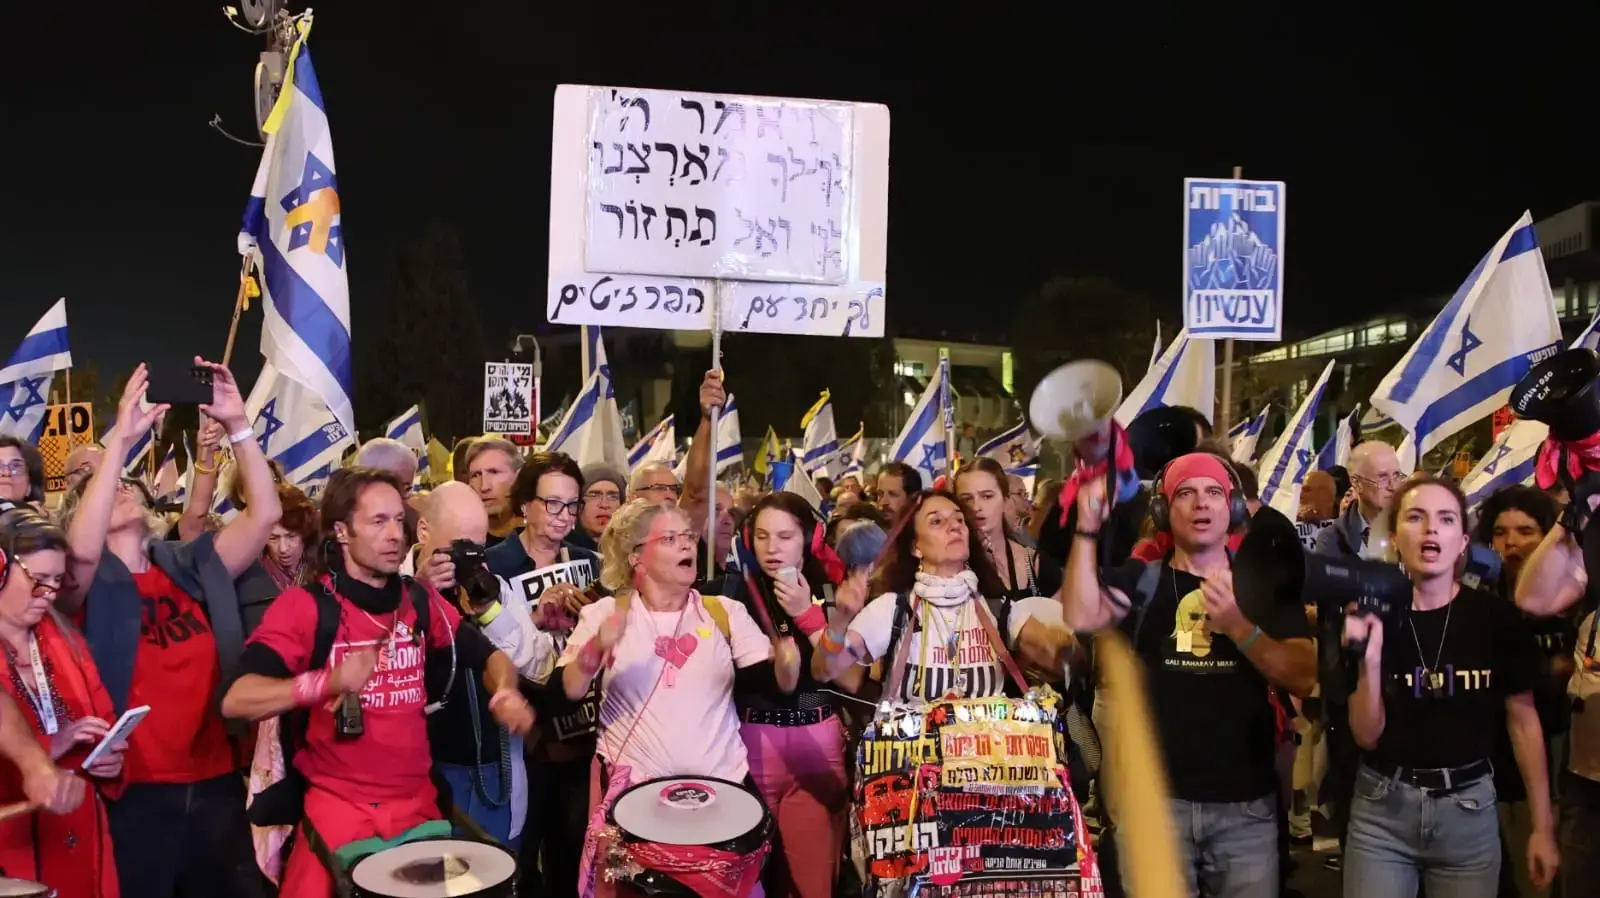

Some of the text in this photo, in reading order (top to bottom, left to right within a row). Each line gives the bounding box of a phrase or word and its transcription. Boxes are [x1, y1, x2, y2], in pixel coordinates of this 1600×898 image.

[1190, 187, 1277, 212] בחירות
[739, 295, 788, 330] עם
[794, 296, 838, 321] יחד
[1195, 293, 1269, 325] עכשיו!
